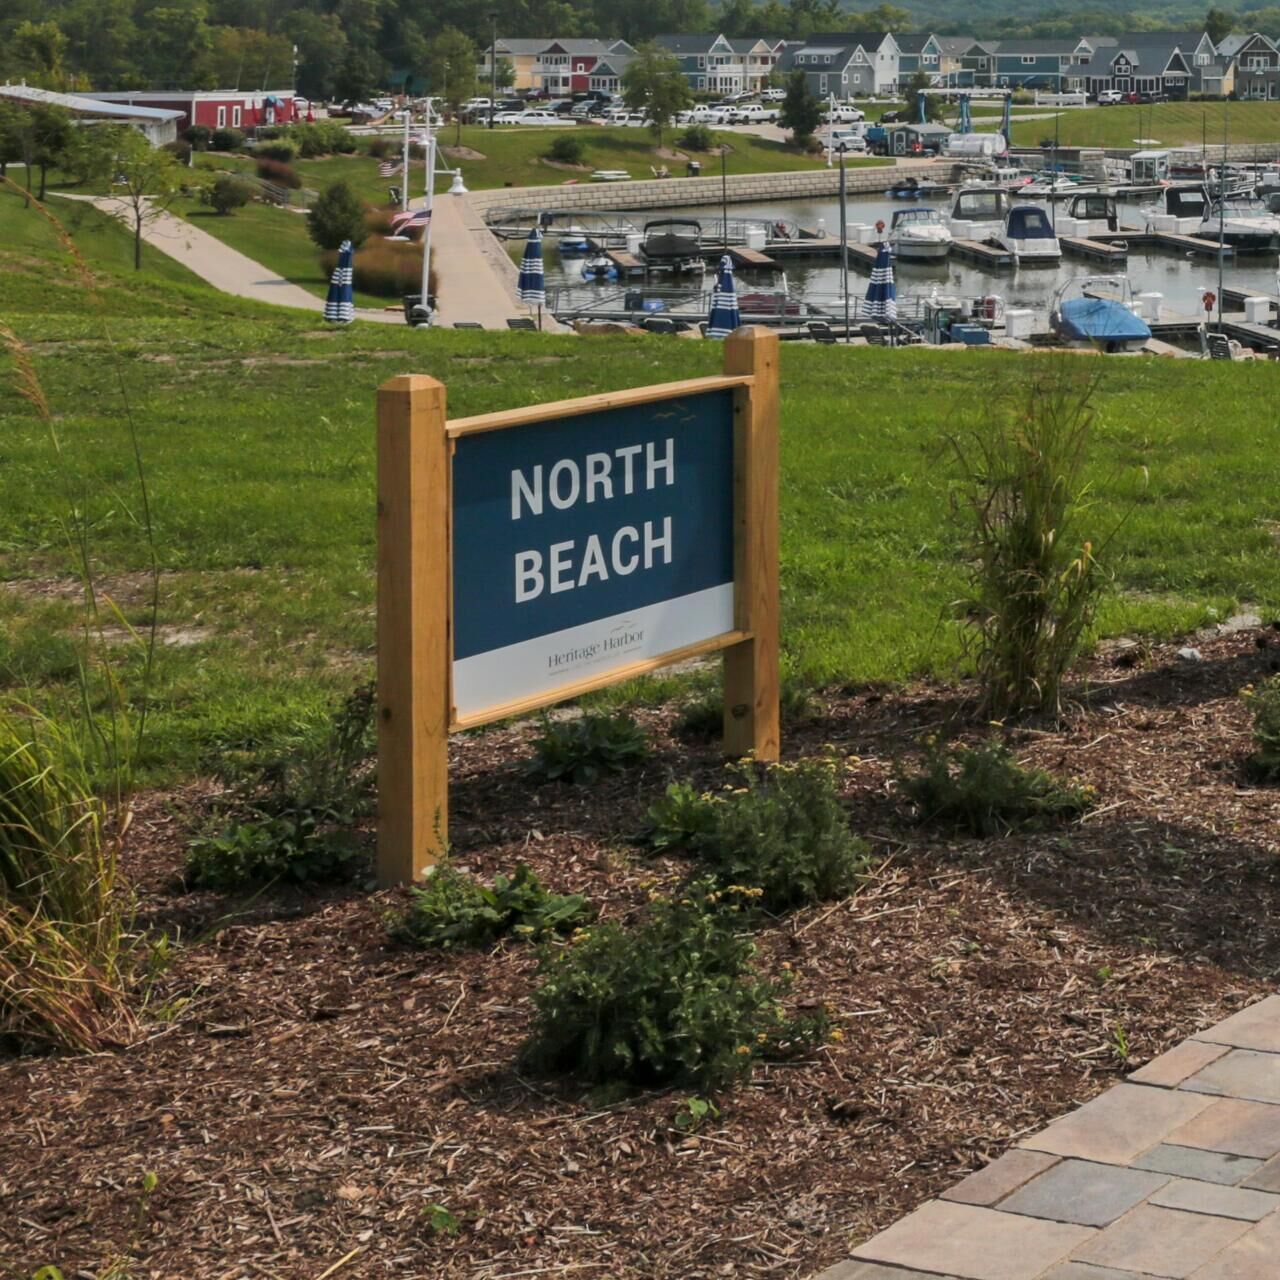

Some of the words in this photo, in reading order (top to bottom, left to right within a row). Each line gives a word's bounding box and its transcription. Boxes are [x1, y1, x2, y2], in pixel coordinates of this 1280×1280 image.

[511, 438, 675, 520] NORTH
[514, 516, 673, 604] BEACH
[548, 644, 601, 668] Heritage
[603, 631, 644, 651] Harbor
